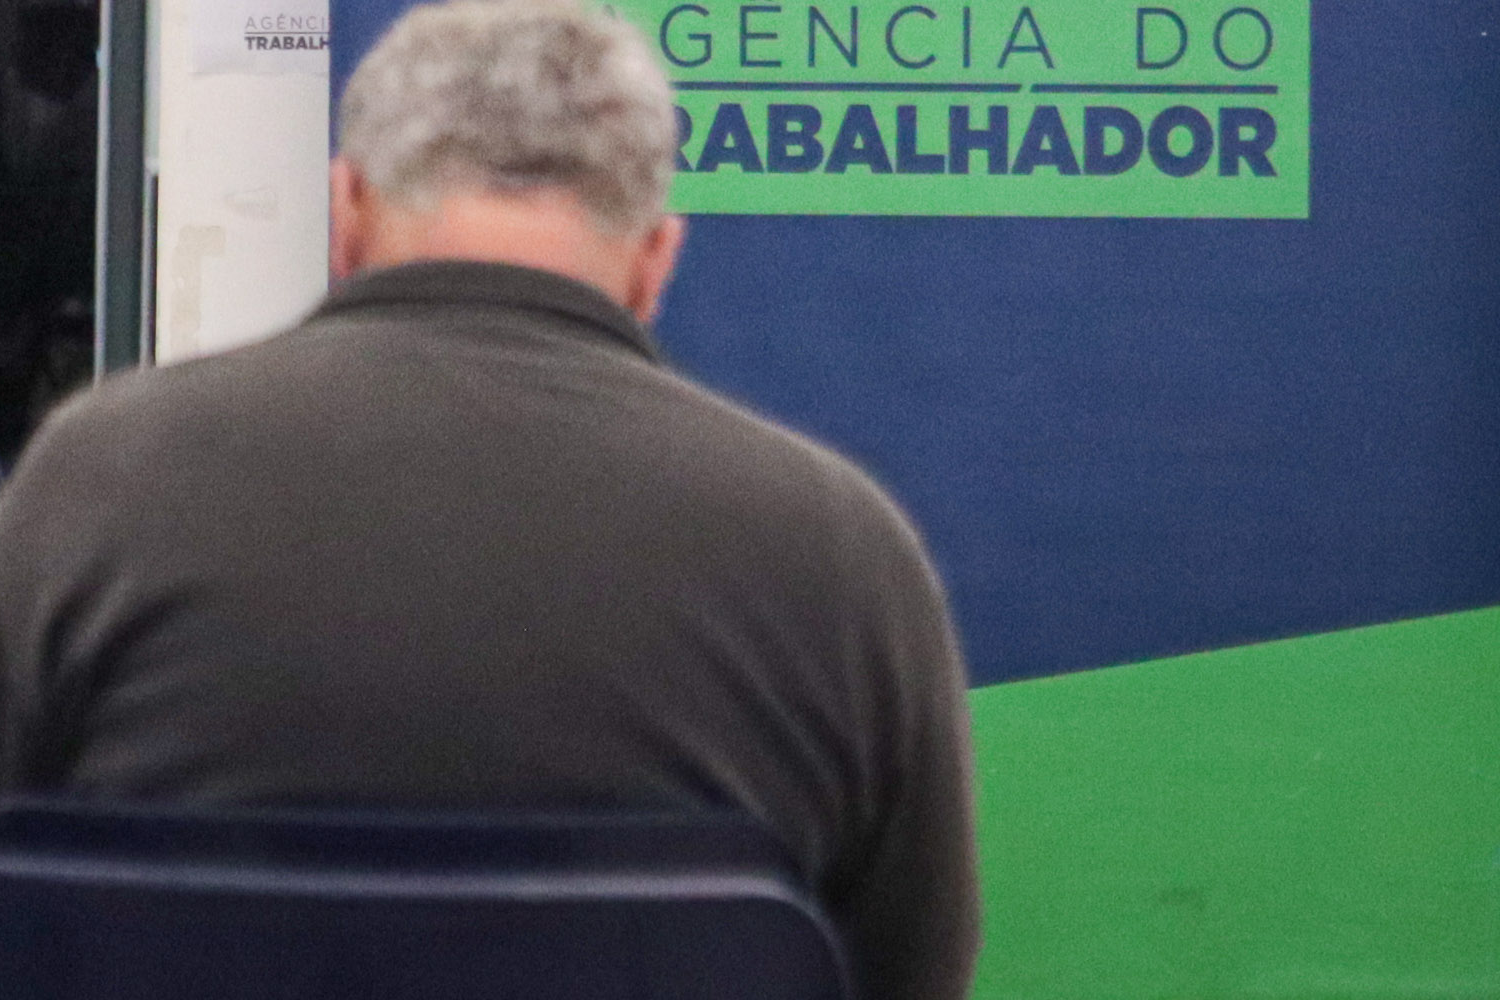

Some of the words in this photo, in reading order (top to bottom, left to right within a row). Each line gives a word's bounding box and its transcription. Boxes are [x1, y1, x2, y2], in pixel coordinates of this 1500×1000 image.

[245, 13, 325, 31] AGÊNCI
[244, 35, 329, 51] TRABALH
[1136, 5, 1274, 71] DO
